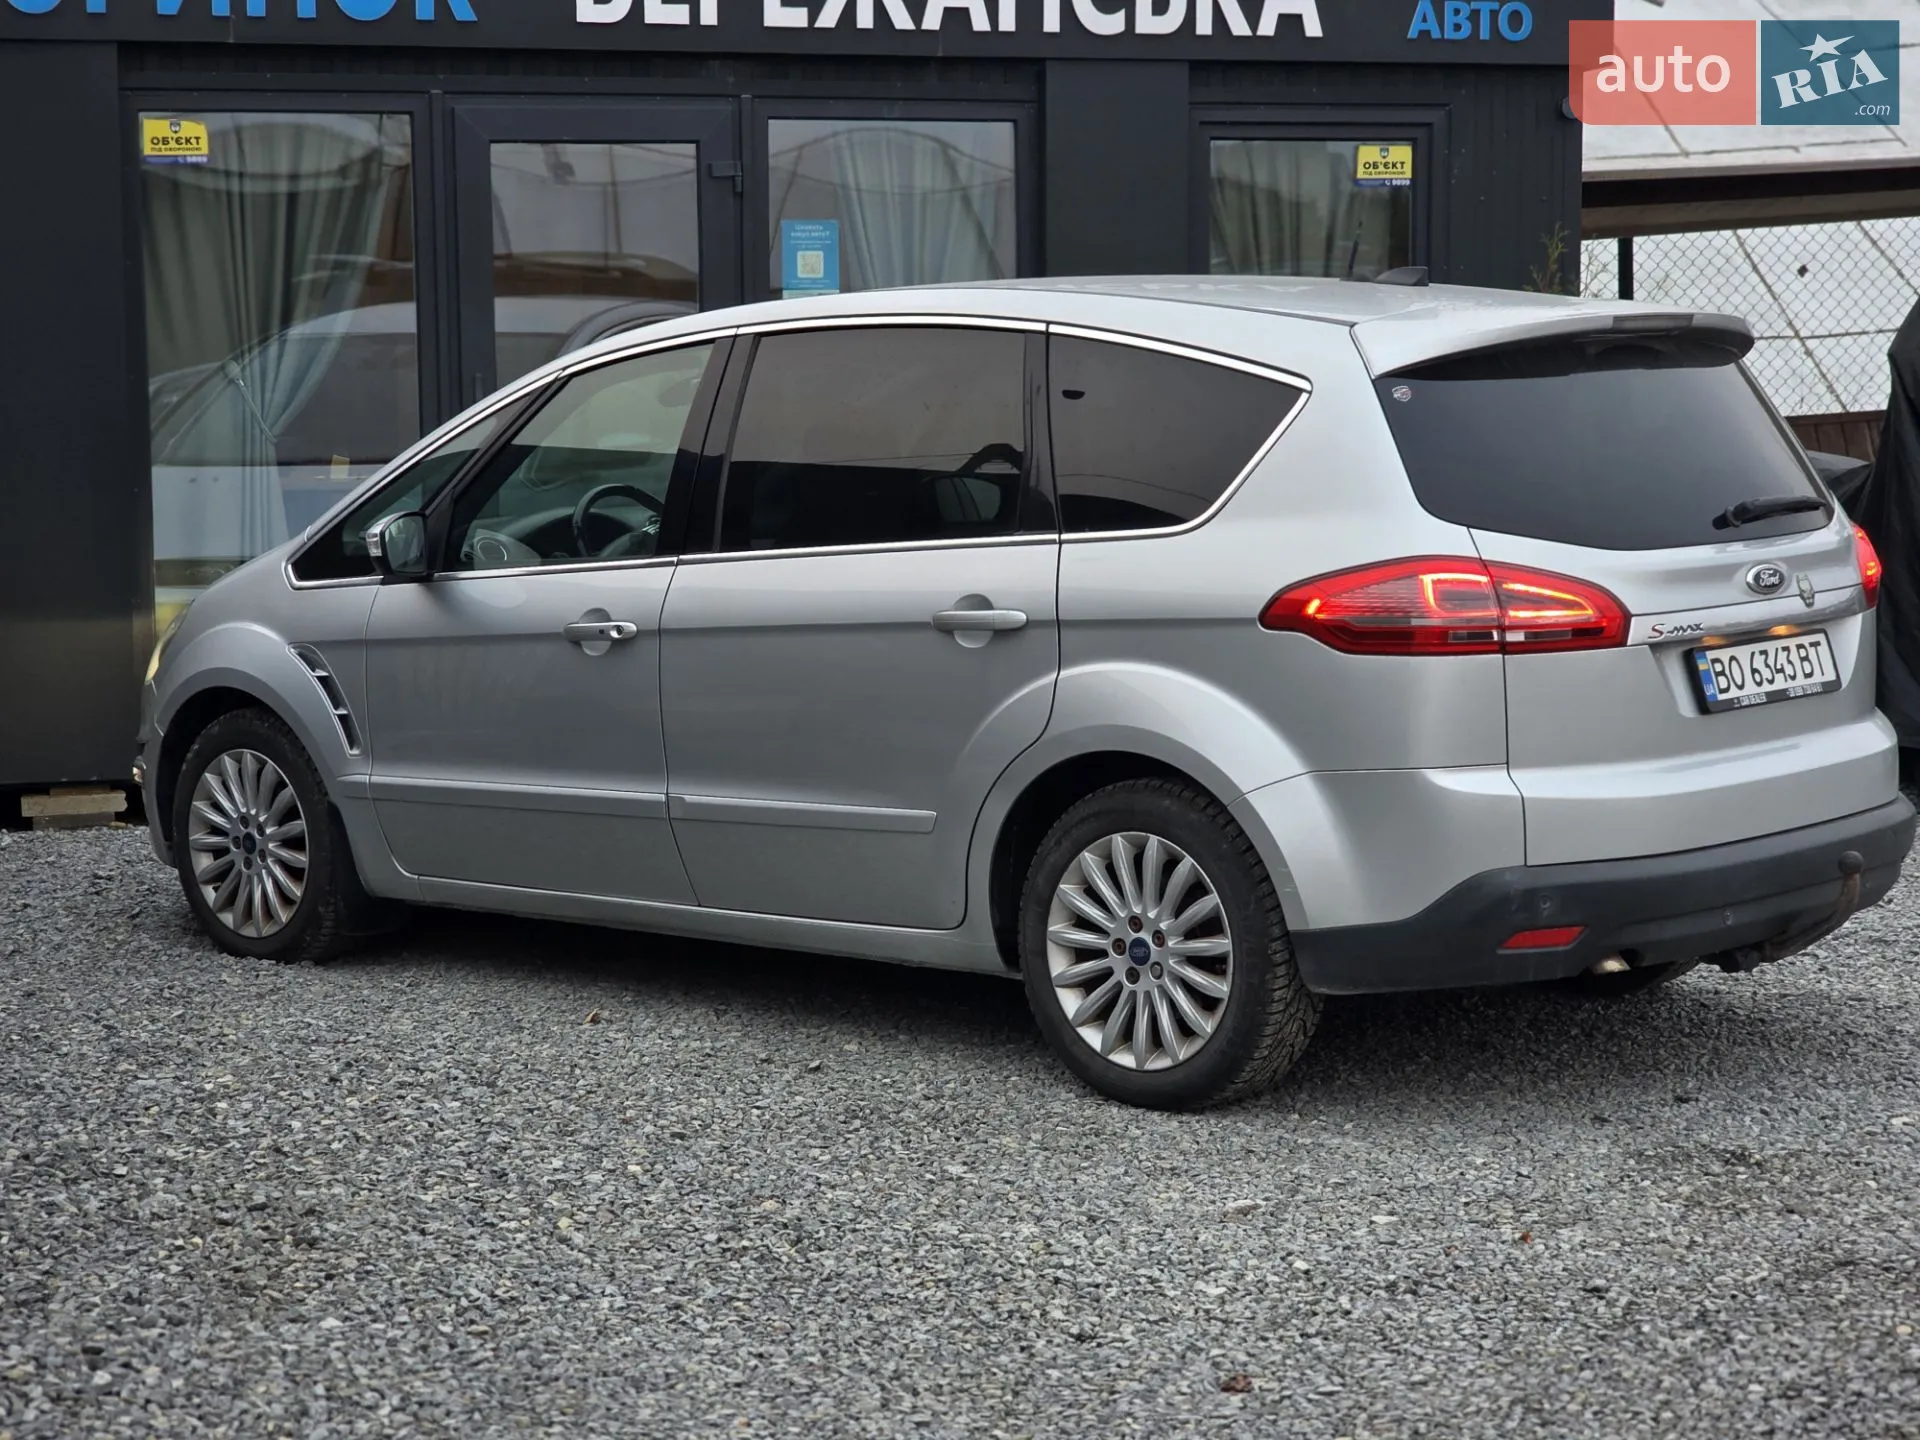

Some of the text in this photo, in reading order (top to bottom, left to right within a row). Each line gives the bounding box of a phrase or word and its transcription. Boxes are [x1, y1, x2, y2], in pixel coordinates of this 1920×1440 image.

[1407, 0, 1533, 41] АВТО
[150, 136, 202, 146] ОБ'ЄКТ
[1362, 161, 1406, 170] ОБ'ЄКТ
[1760, 569, 1780, 587] Ford
[1710, 640, 1825, 694] BO 6343 BT
